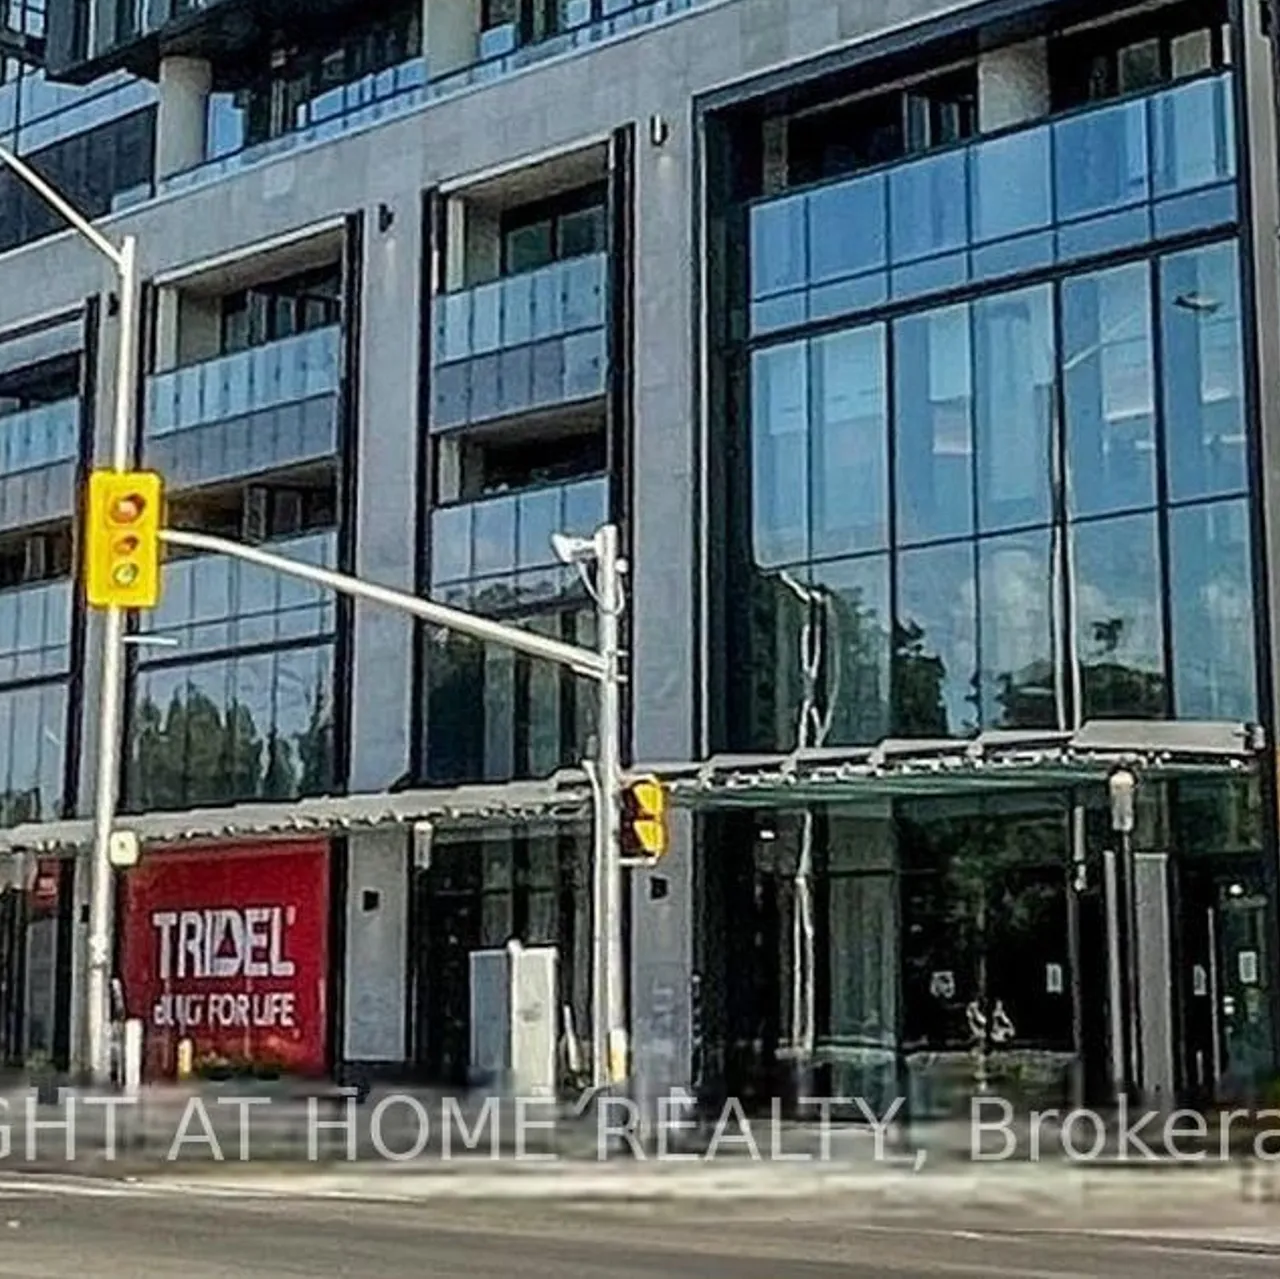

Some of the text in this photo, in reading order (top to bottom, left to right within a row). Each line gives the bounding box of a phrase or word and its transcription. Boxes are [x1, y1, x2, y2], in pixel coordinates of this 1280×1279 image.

[152, 906, 296, 979] TRIDEL
[208, 992, 250, 1026] FOR
[252, 991, 296, 1027] LIFE
